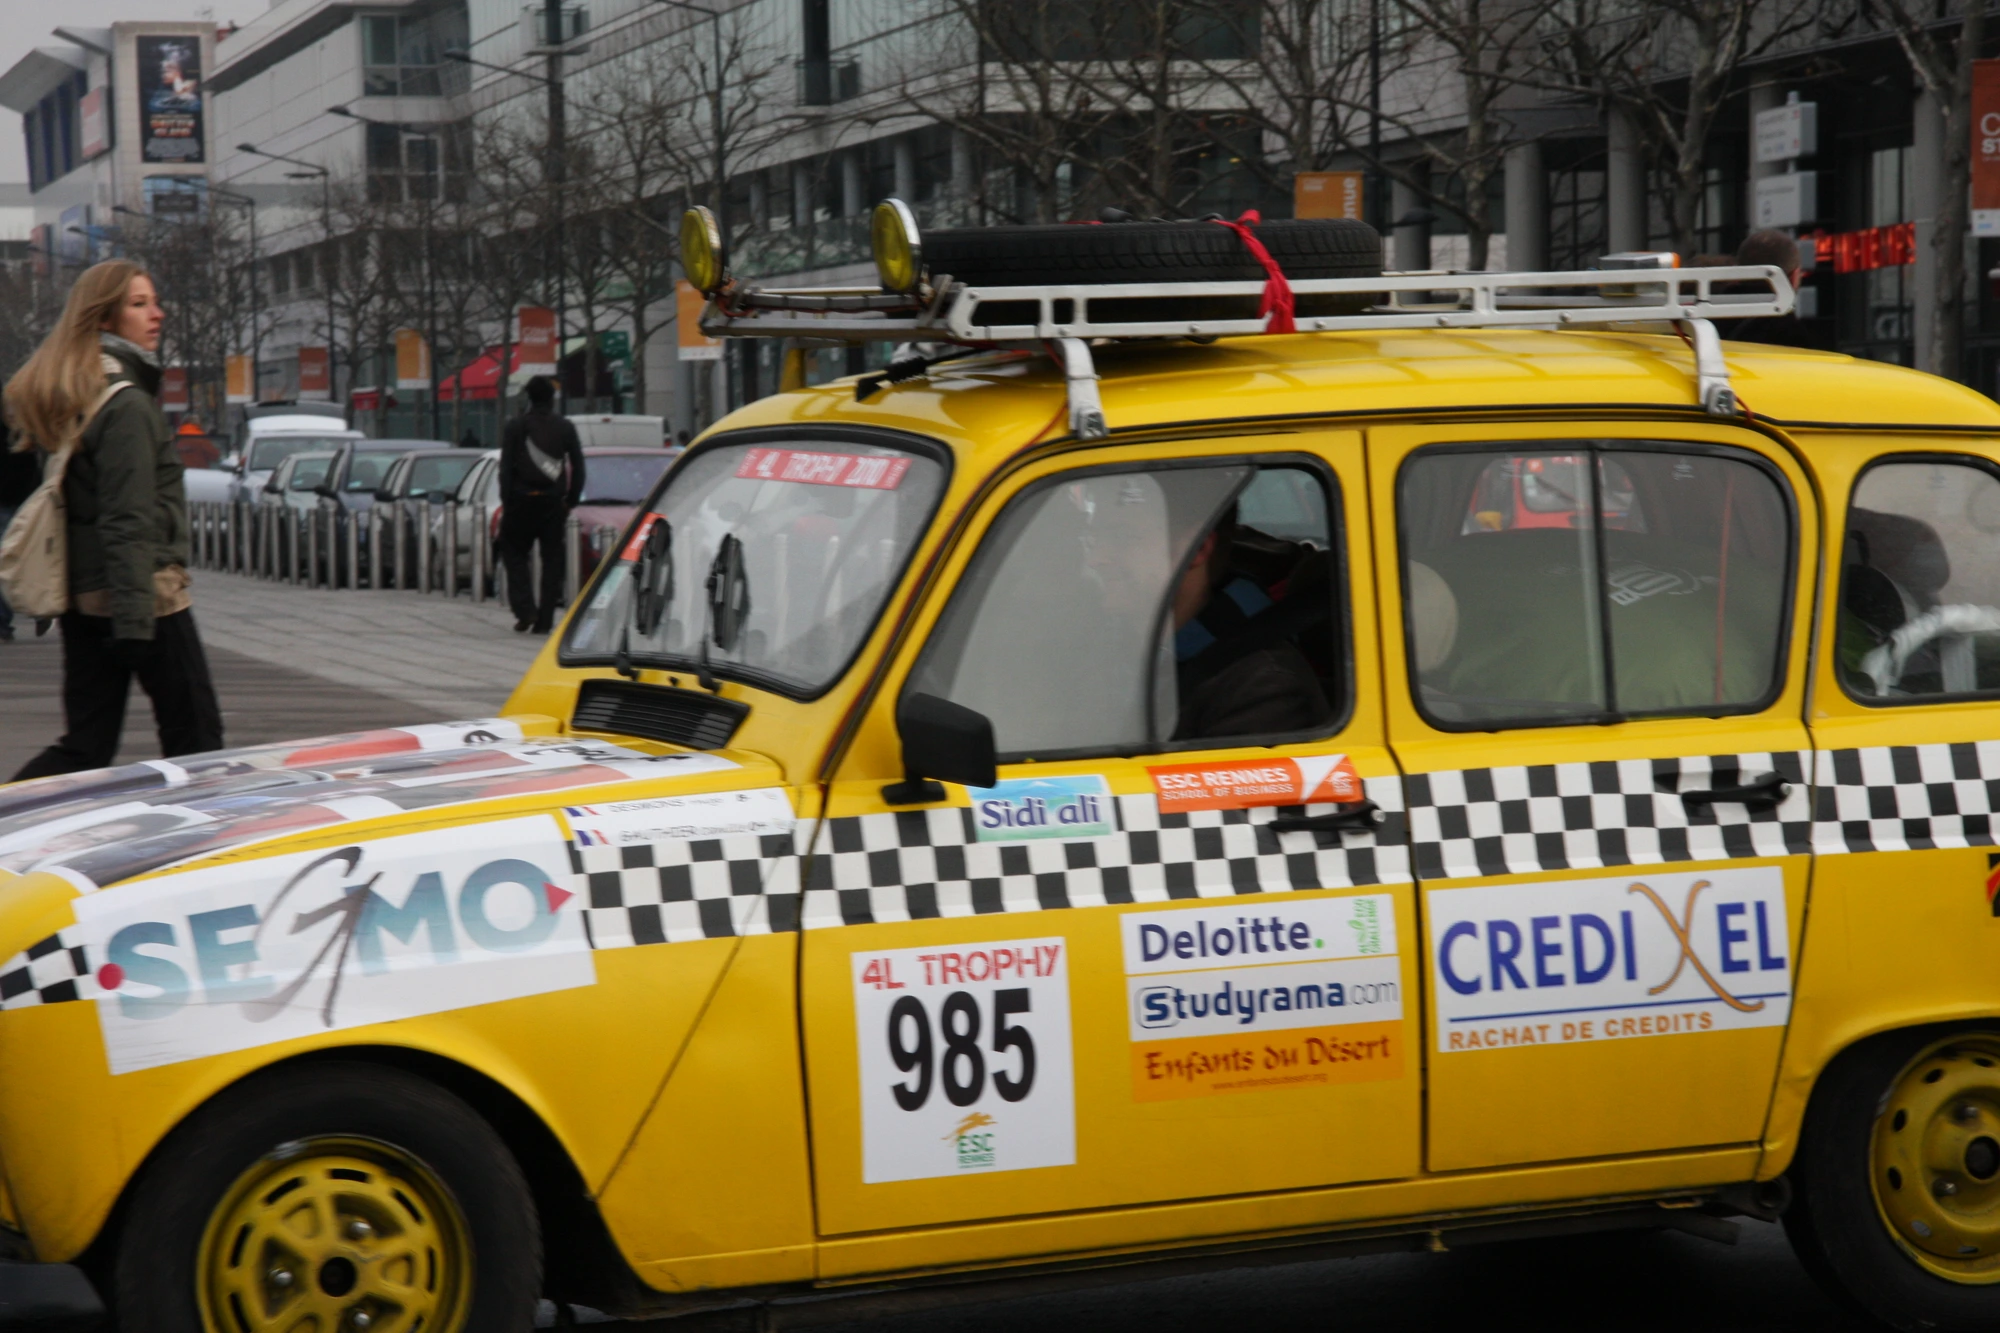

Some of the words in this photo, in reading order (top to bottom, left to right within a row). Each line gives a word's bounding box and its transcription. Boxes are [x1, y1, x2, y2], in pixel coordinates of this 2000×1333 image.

[1156, 774, 1201, 789] ESC
[1200, 768, 1290, 786] RENNES
[1162, 787, 1210, 800] SCHOOL
[1214, 786, 1230, 796] OF
[1234, 784, 1293, 796] BUSINESS
[981, 796, 1046, 829] Sidi
[1058, 793, 1099, 825] ali
[1439, 880, 1786, 1012] CREDIXEL
[861, 958, 906, 990] 4L
[916, 945, 1063, 986] TROPHY
[1144, 980, 1398, 1025] Studyrama.com
[888, 987, 1037, 1112] 985
[1450, 1024, 1551, 1050] RACHAT
[1561, 1021, 1593, 1041] DE
[1604, 1011, 1713, 1038] CREDITS
[1144, 1046, 1254, 1082] Enfants
[1263, 1042, 1299, 1070] du
[957, 1133, 996, 1154] ESC
